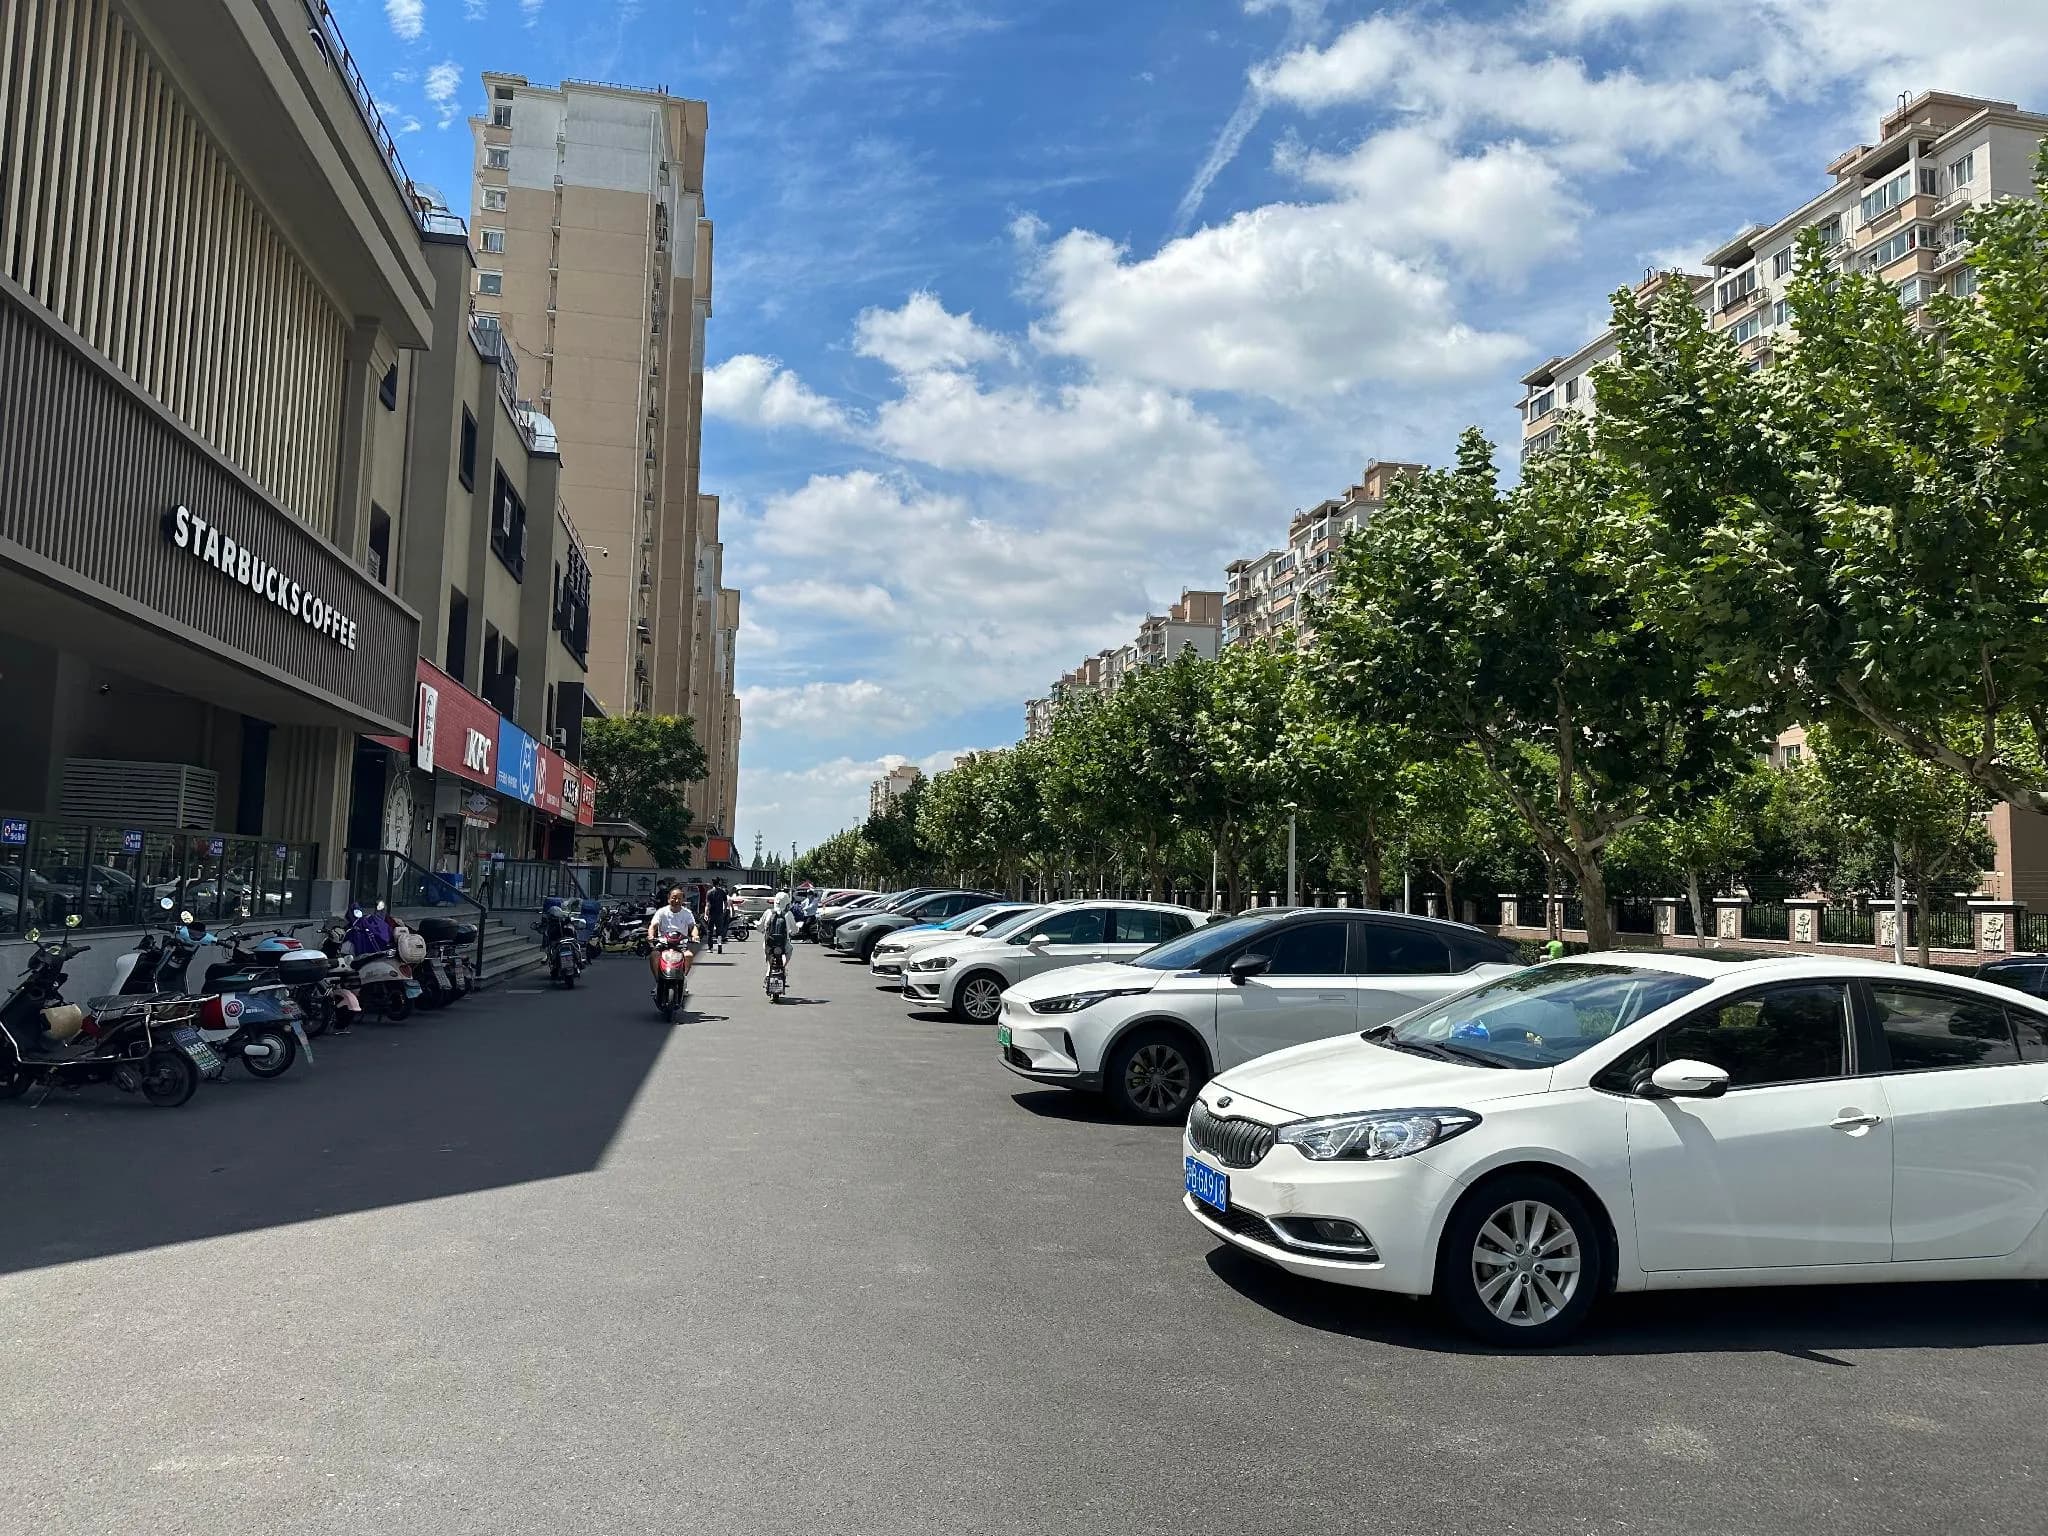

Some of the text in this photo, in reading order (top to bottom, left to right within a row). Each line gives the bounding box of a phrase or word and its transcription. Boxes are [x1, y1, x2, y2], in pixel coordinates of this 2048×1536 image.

[174, 505, 356, 650] STARBUCKS COFFEE
[466, 728, 491, 775] KFC
